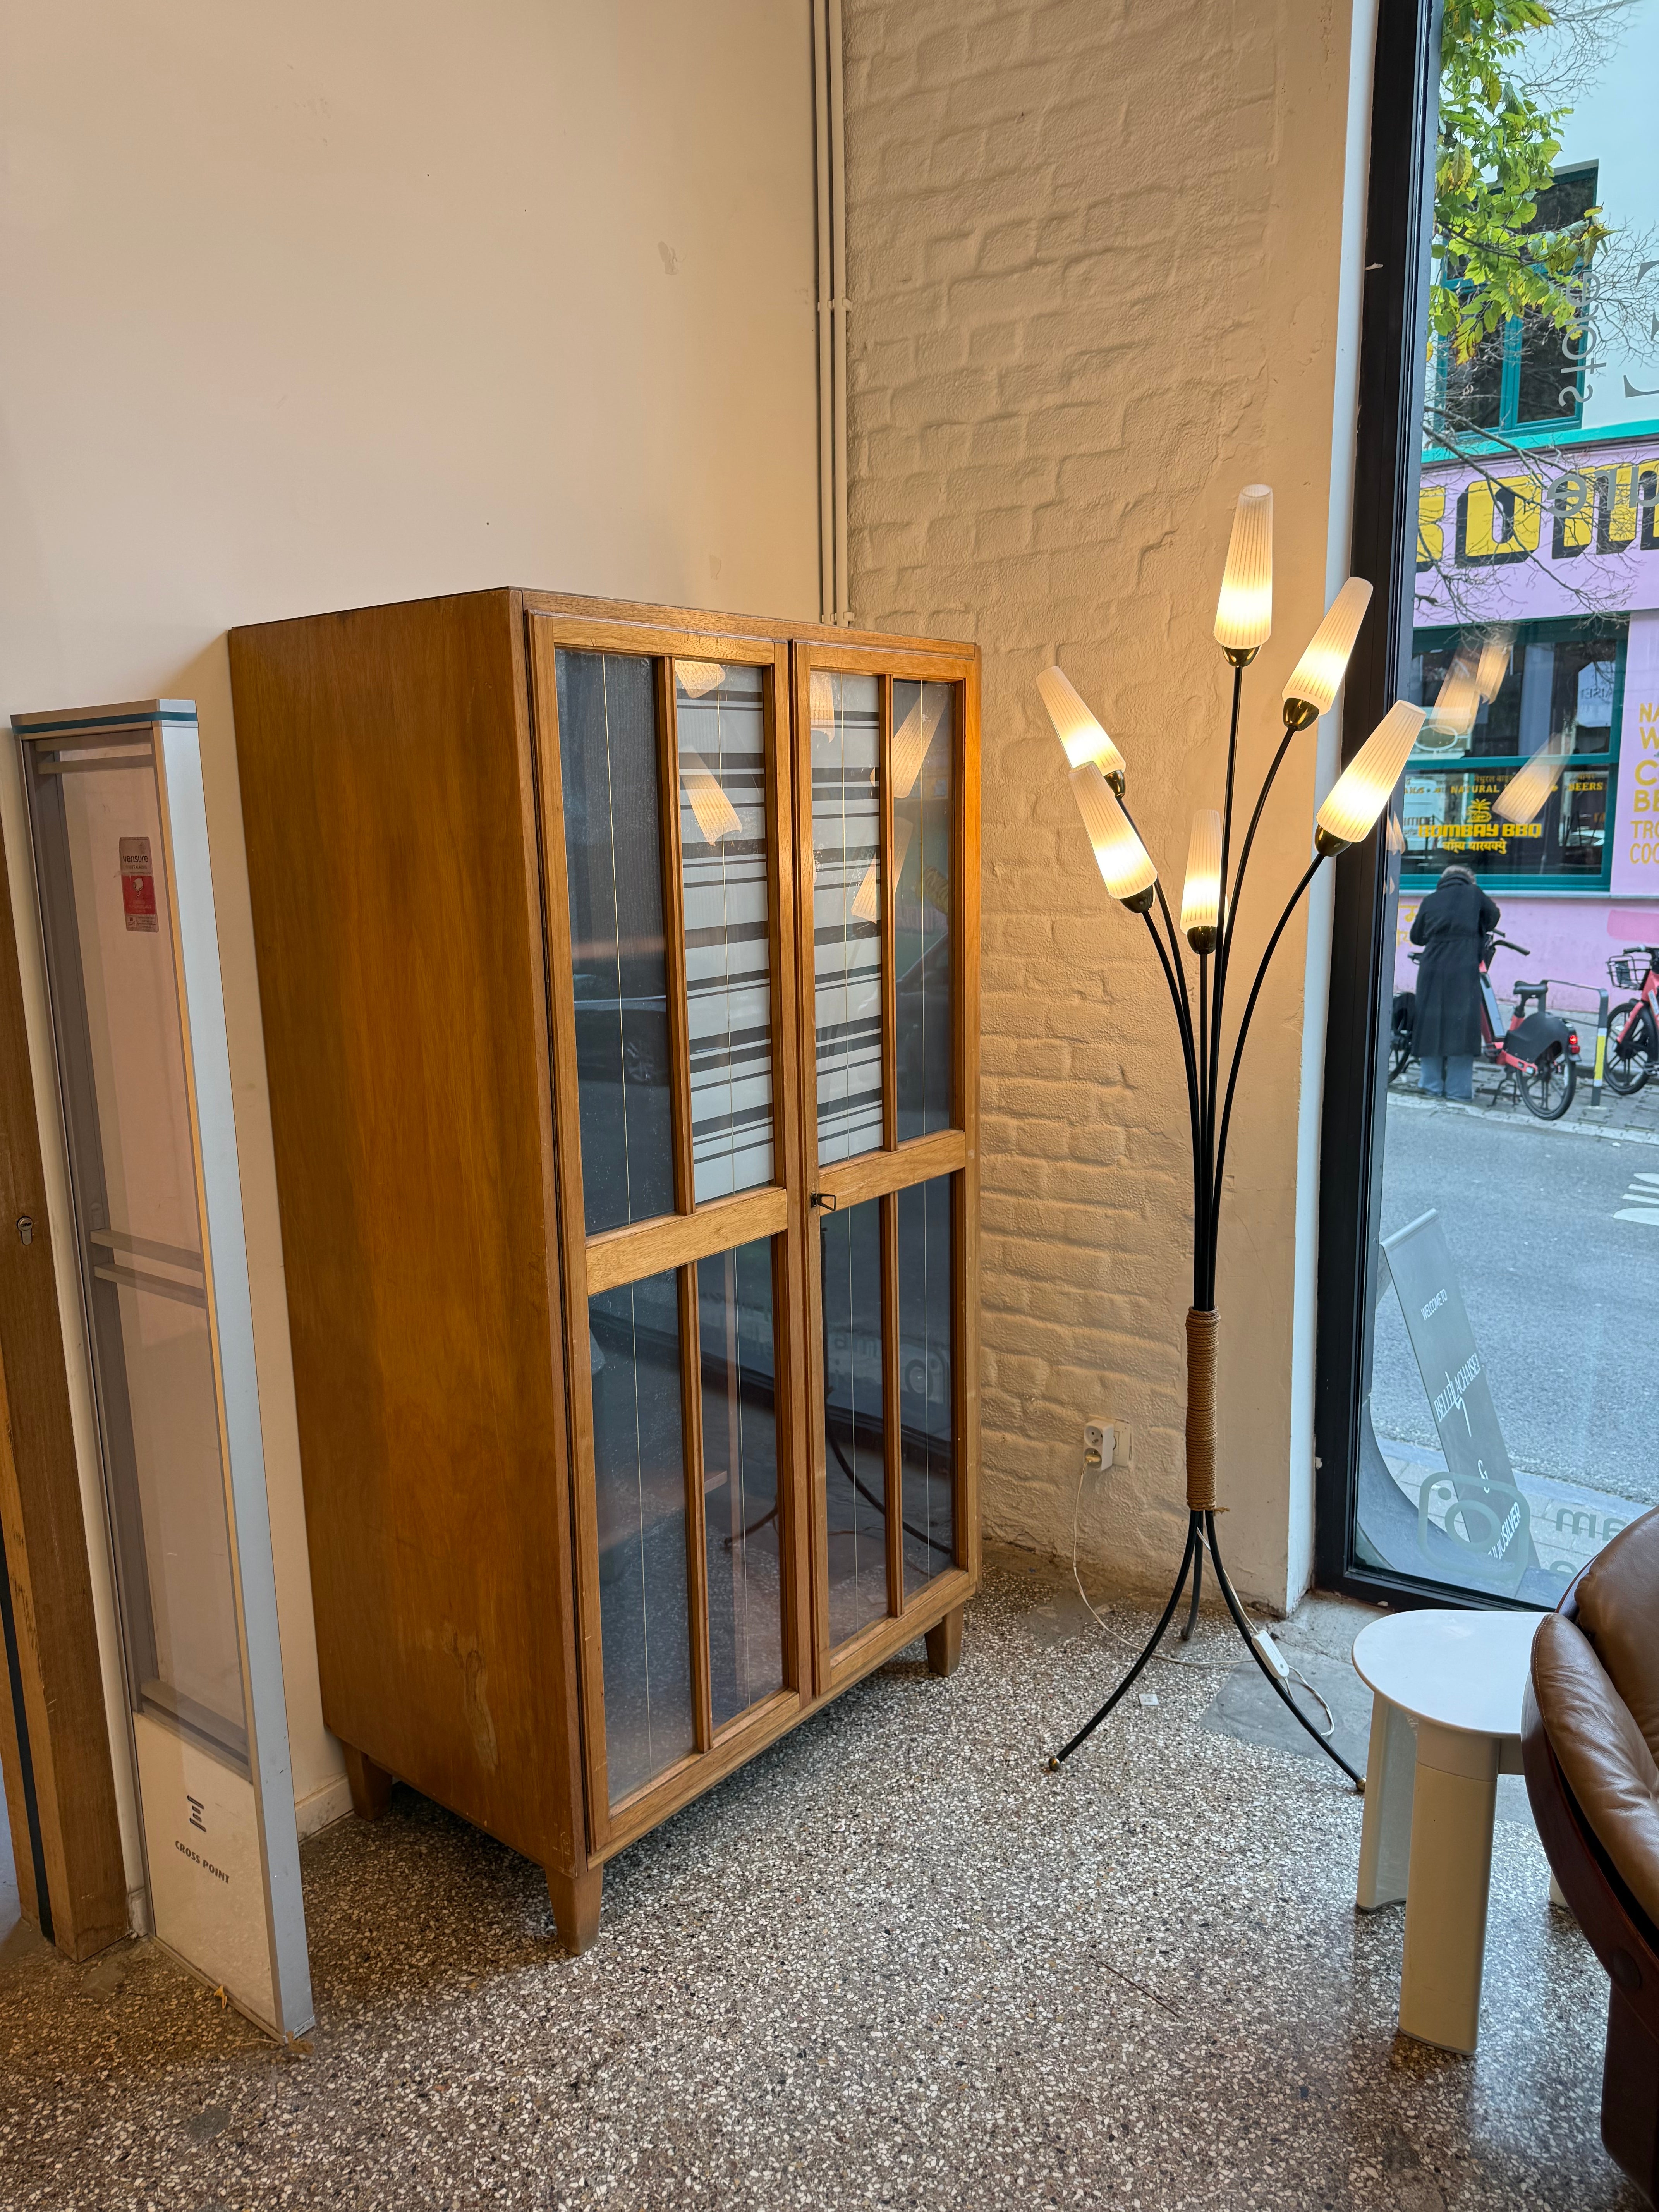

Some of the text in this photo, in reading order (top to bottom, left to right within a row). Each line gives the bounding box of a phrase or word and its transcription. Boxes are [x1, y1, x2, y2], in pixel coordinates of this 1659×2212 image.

[1451, 785, 1499, 793] NATURAL
[1568, 781, 1603, 791] BEERS
[1418, 823, 1542, 838] BOMBAY BBQ
[1421, 1289, 1447, 1320] WELCOME TO
[175, 1841, 230, 1884] CROSS POINT
